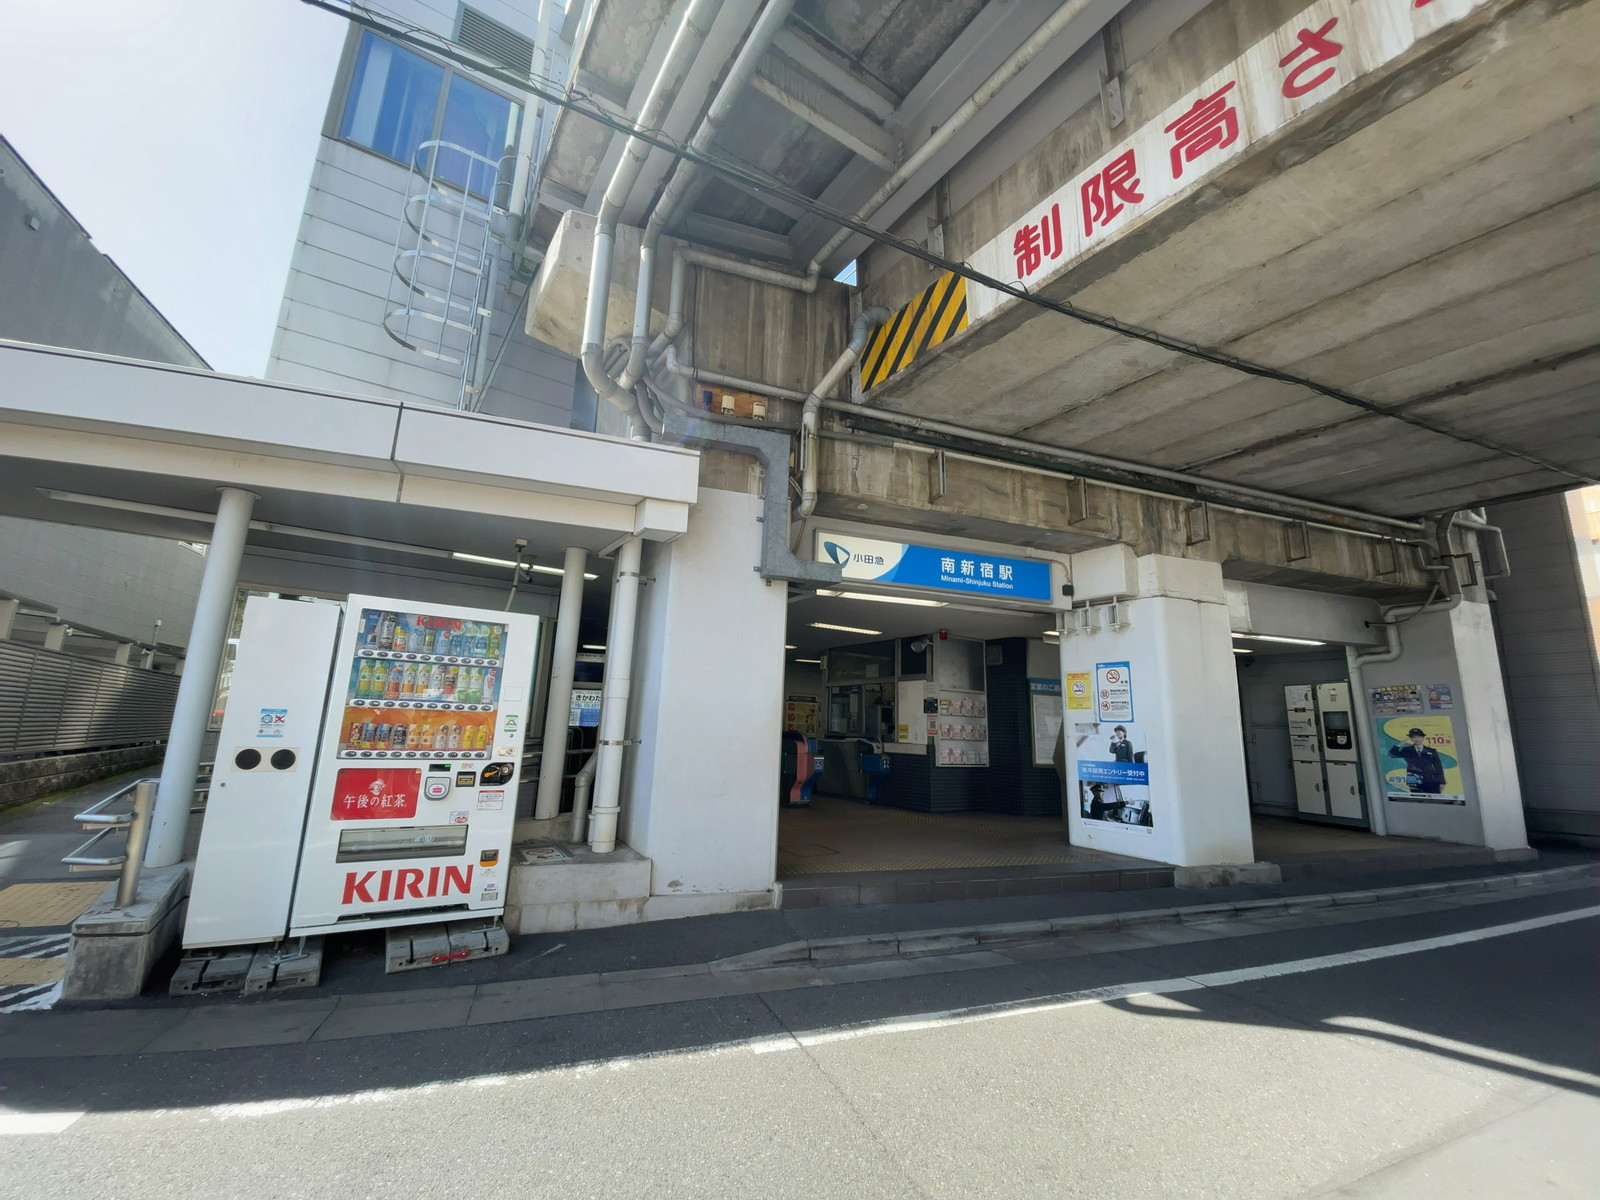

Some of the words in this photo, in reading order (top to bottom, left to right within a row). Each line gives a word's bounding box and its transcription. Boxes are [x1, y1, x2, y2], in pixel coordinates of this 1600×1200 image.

[853, 554, 884, 565] 小田急
[940, 557, 1013, 581] 南新宿駅
[940, 575, 991, 587] Minami-Shinjuku
[992, 580, 1013, 590] Station
[416, 615, 462, 631] KIRIN
[343, 794, 406, 809] 午後の紅茶
[341, 864, 475, 905] KIRIN
